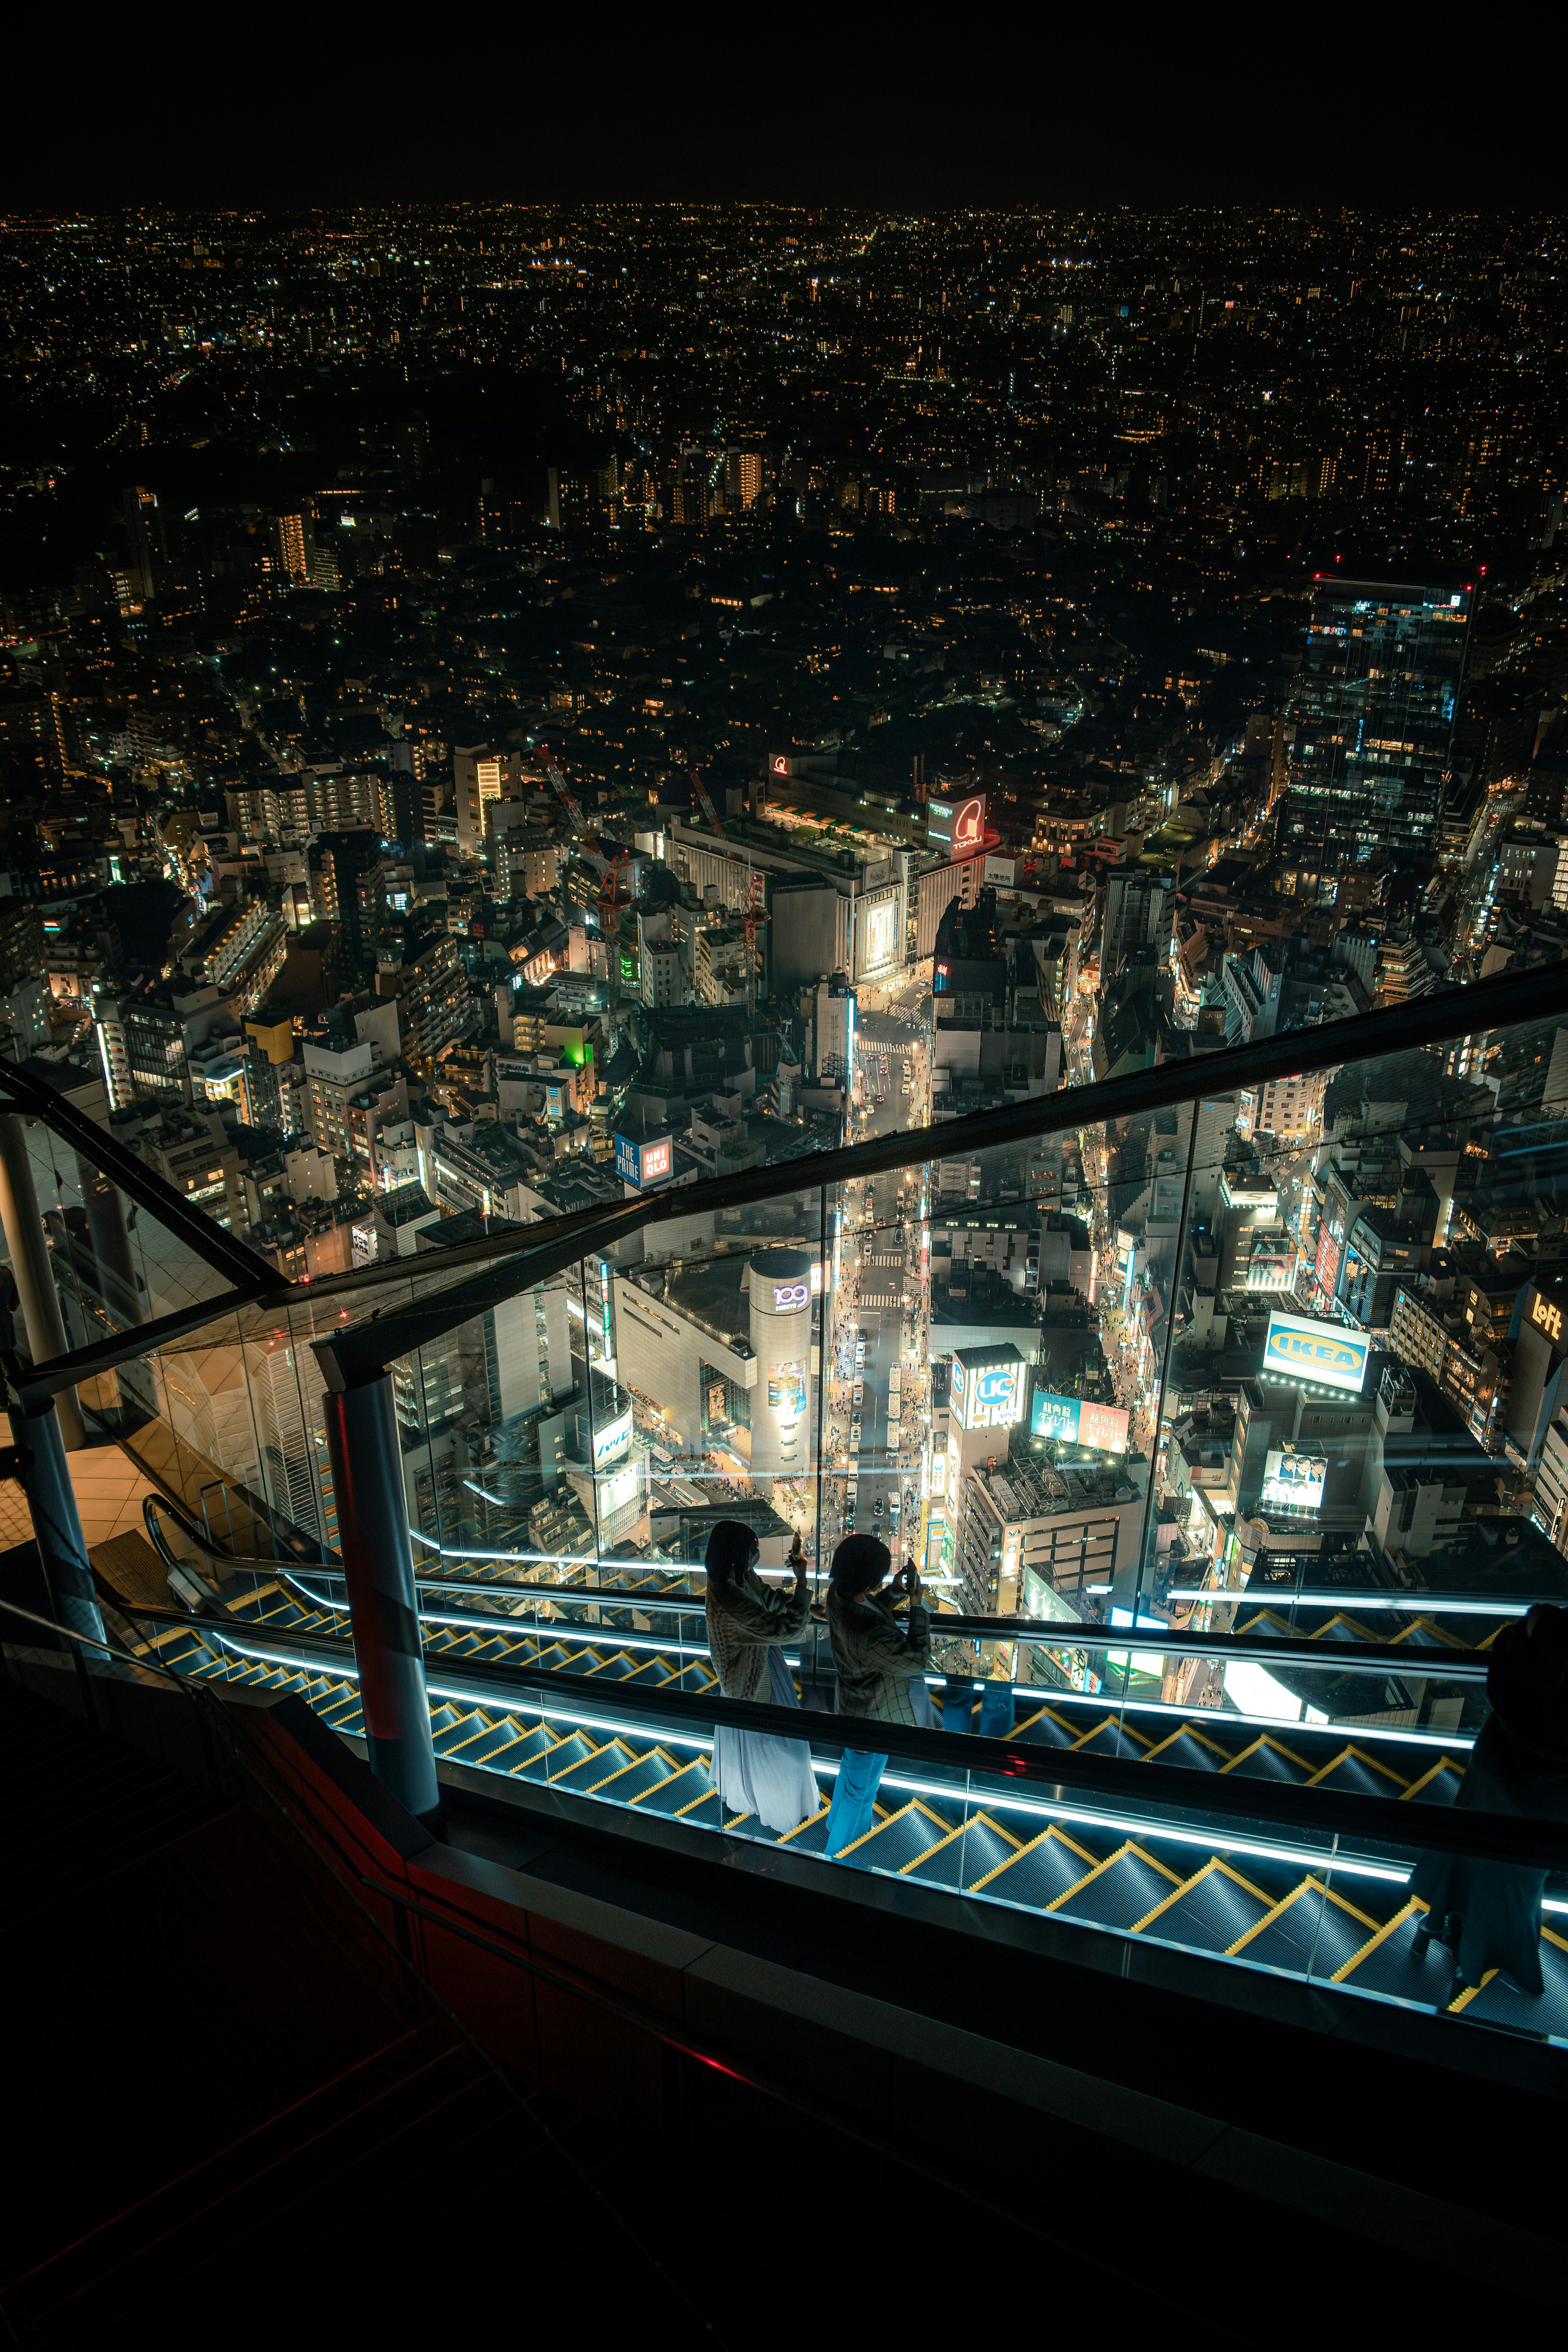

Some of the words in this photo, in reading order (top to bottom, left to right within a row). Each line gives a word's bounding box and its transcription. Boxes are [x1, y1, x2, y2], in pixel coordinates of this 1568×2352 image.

[928, 831, 951, 842] Bunkamura
[953, 835, 983, 850] TOKYU
[621, 1141, 634, 1163] THE
[646, 1148, 665, 1163] UNI
[617, 1155, 639, 1181] PRIME
[646, 1159, 667, 1176] QLO
[1317, 1240, 1328, 1283] Bershka
[773, 1285, 808, 1309] 109
[1277, 1336, 1355, 1367] IKEA
[979, 1377, 1015, 1399] UC
[1042, 1401, 1071, 1418] 龍角散
[1089, 1412, 1119, 1428] 龍角散
